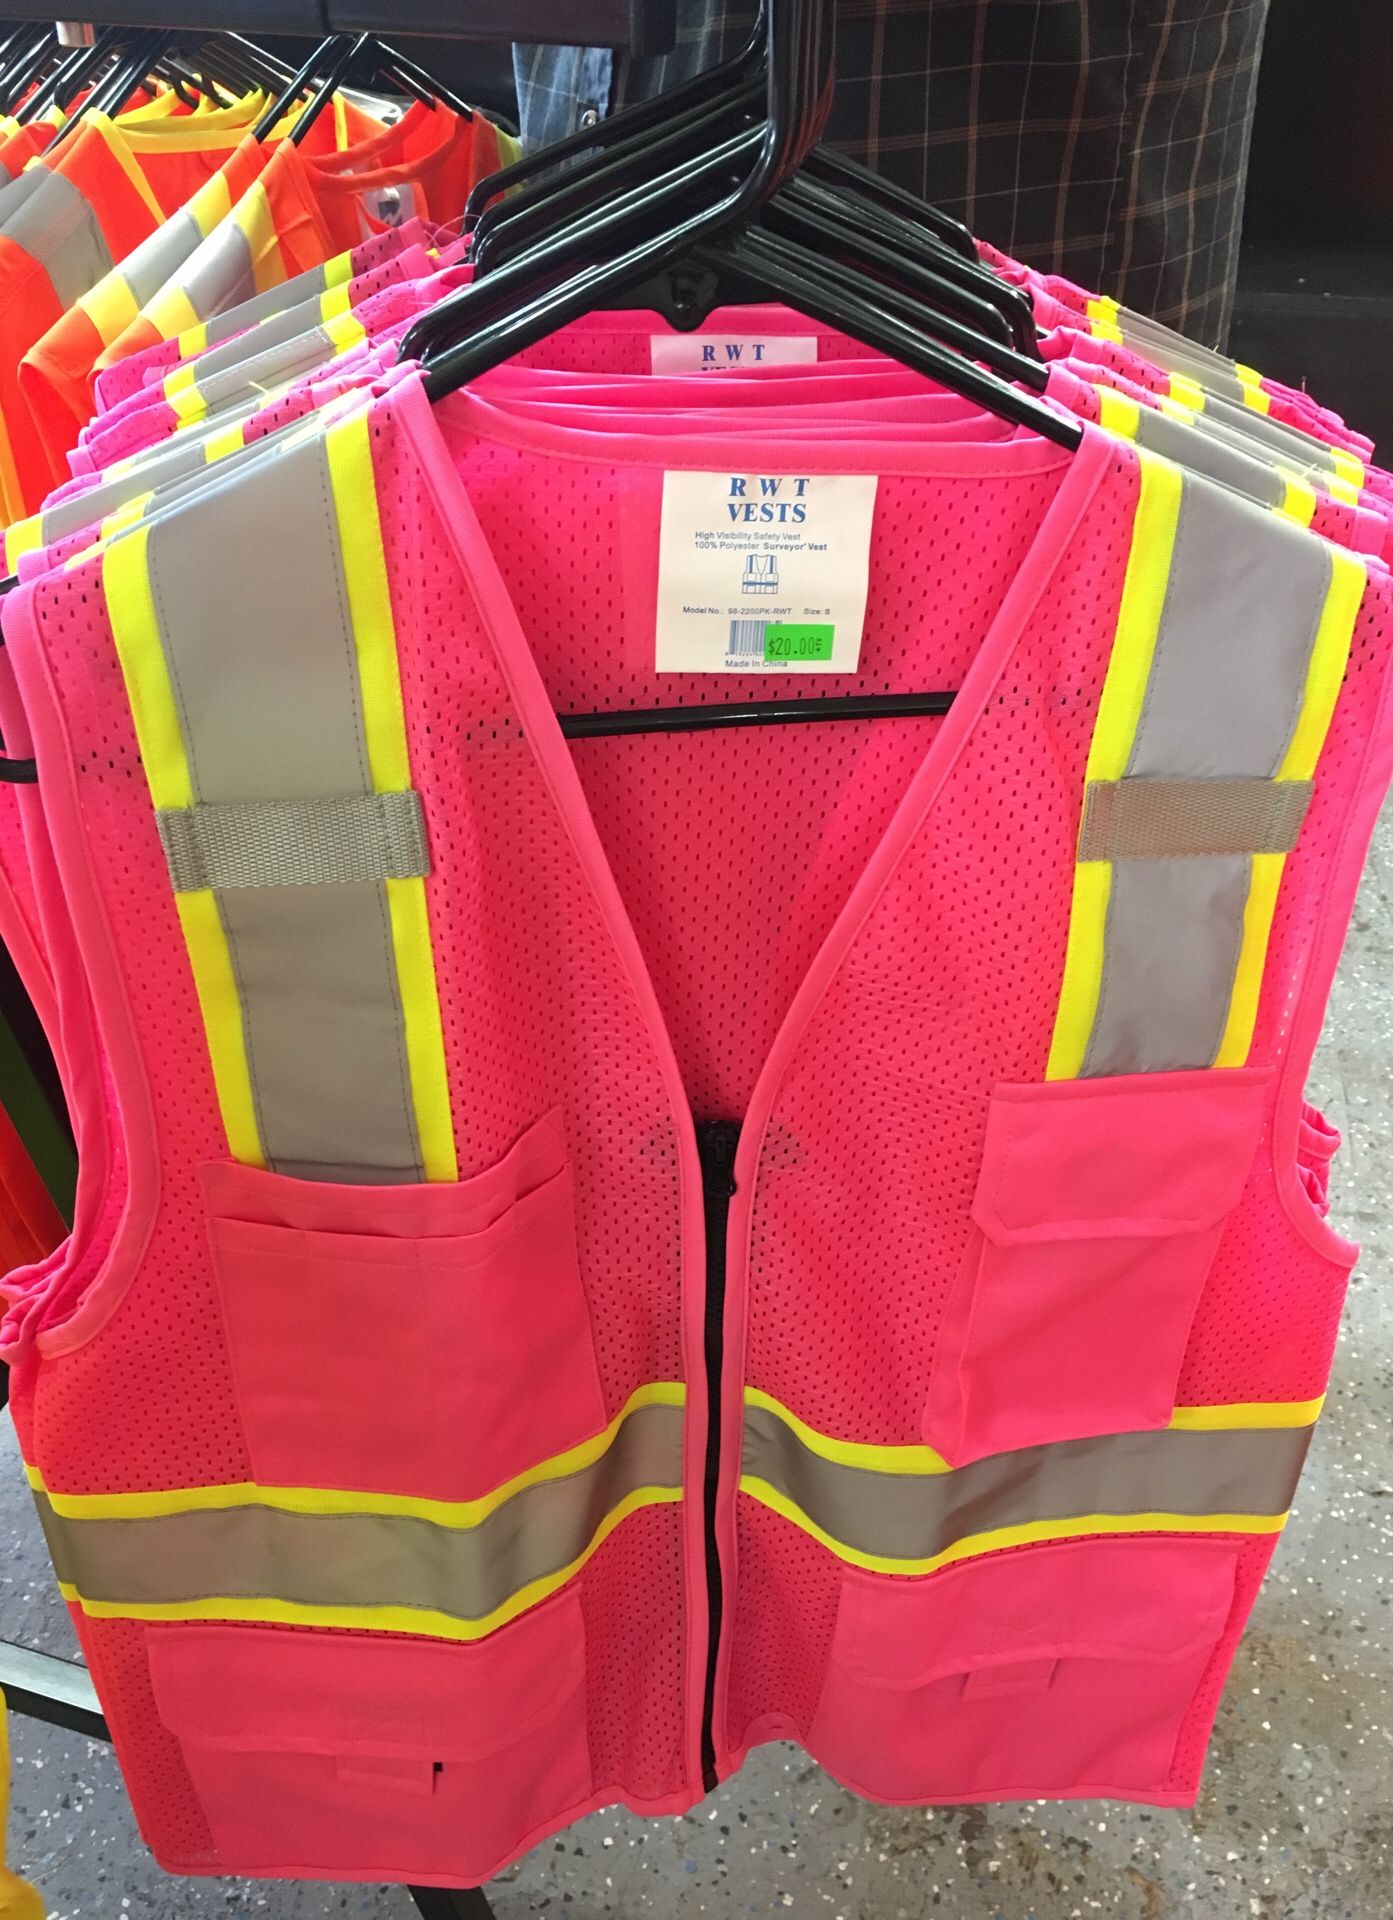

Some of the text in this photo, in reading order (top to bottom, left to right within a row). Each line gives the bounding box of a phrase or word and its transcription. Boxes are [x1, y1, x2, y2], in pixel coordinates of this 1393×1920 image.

[727, 503, 806, 523] VESTS
[695, 532, 801, 541] High Visibility Safety Vest
[694, 541, 718, 549] 100%
[719, 541, 760, 551] Polyester
[808, 543, 828, 551] Vest
[683, 606, 706, 614] Model
[725, 660, 788, 668] Made In China
